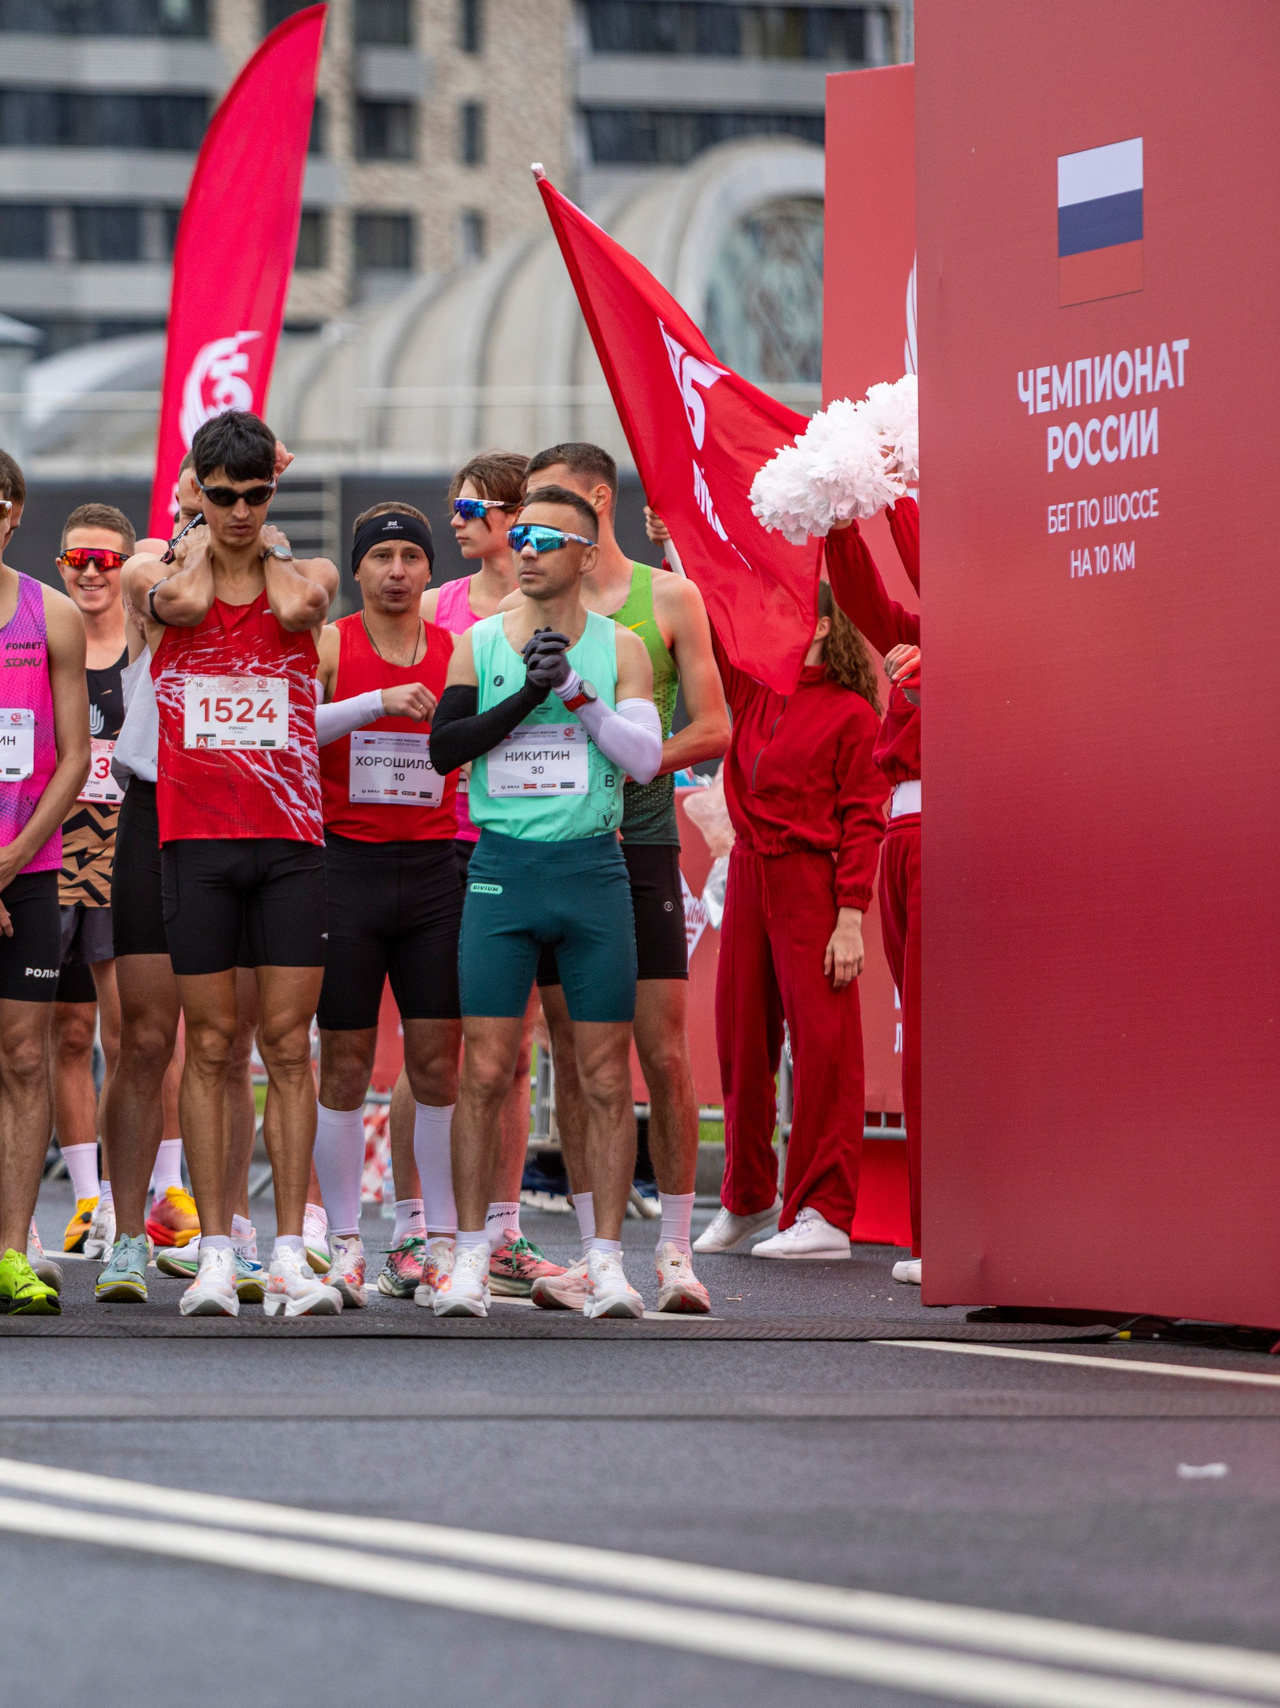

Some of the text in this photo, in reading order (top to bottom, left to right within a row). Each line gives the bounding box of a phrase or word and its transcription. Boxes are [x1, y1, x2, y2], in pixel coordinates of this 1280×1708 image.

[1018, 338, 1190, 416] ЧЕМПИОНАТ
[1047, 407, 1158, 473] РОССИИ
[1048, 488, 1159, 534] БЕГ ПО ШОССЕ
[1070, 540, 1135, 578] НА 10 КМ
[6, 642, 43, 650] FONBET
[199, 698, 277, 723] 1524
[356, 756, 436, 770] ХОРОШИЛО
[505, 750, 570, 762] НИКИТИН
[90, 757, 110, 779] 3
[394, 773, 405, 781] 10
